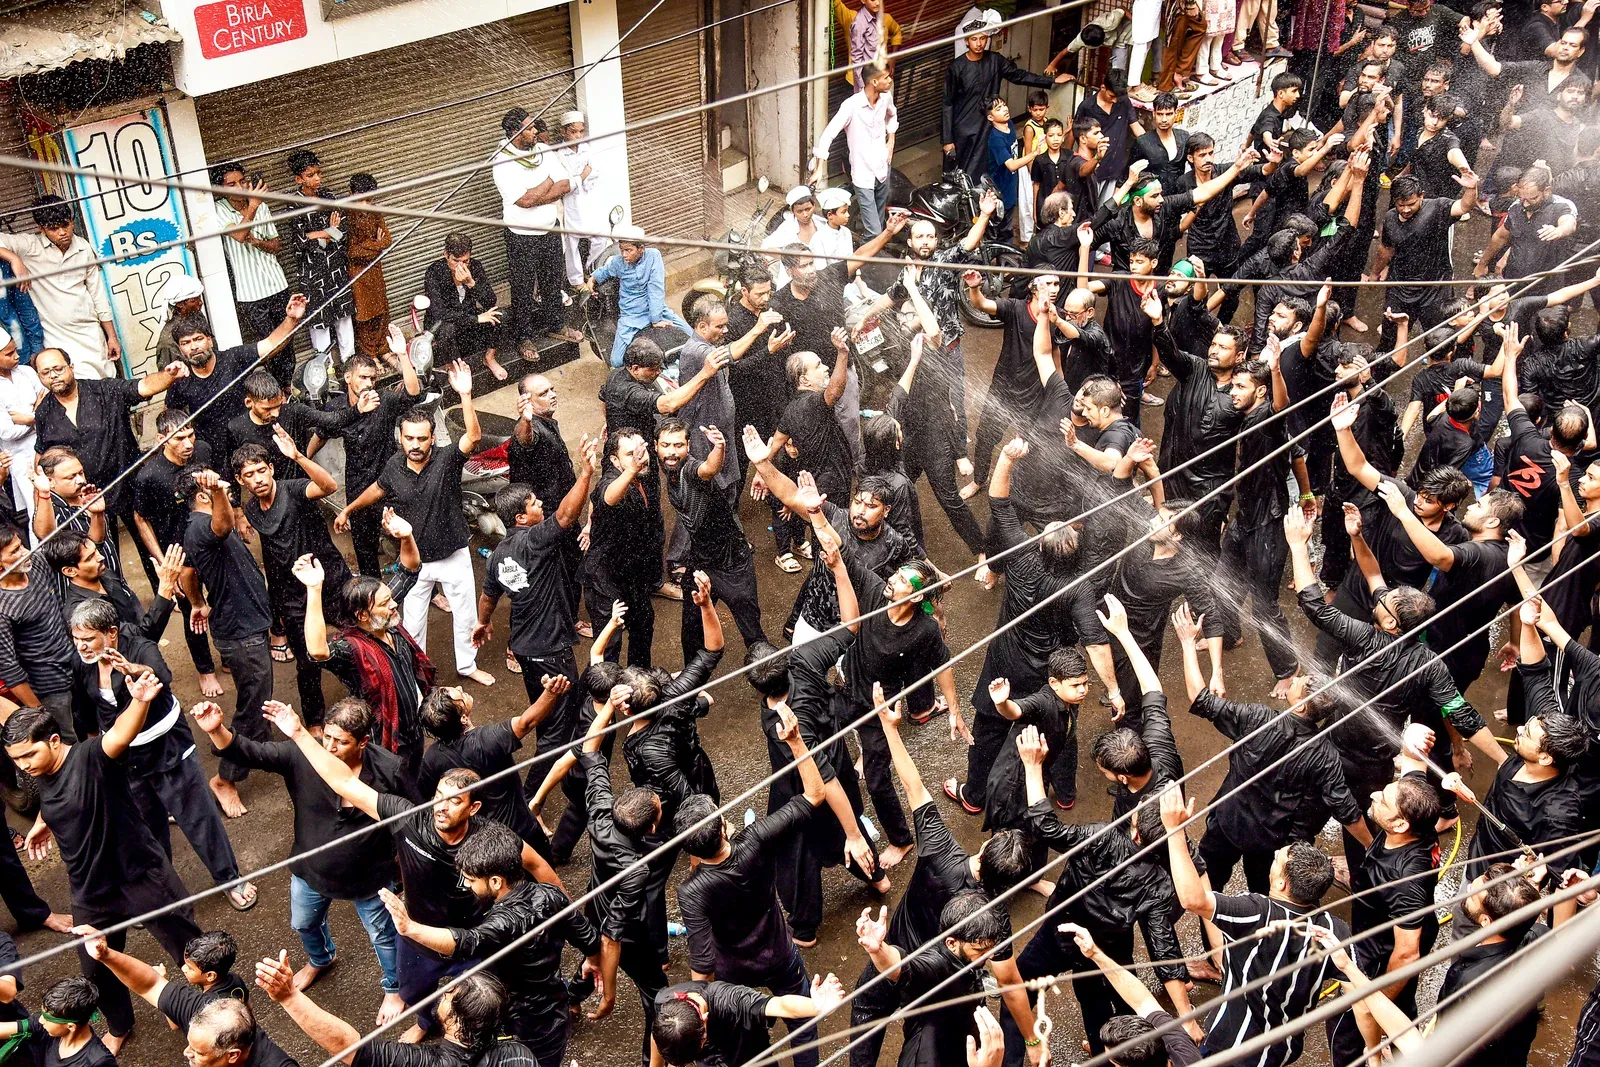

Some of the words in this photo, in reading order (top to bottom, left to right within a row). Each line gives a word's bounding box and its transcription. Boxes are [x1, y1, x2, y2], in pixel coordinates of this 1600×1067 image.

[225, 2, 274, 27] BIRLA
[213, 19, 293, 51] CENTURY
[75, 121, 170, 220] 10
